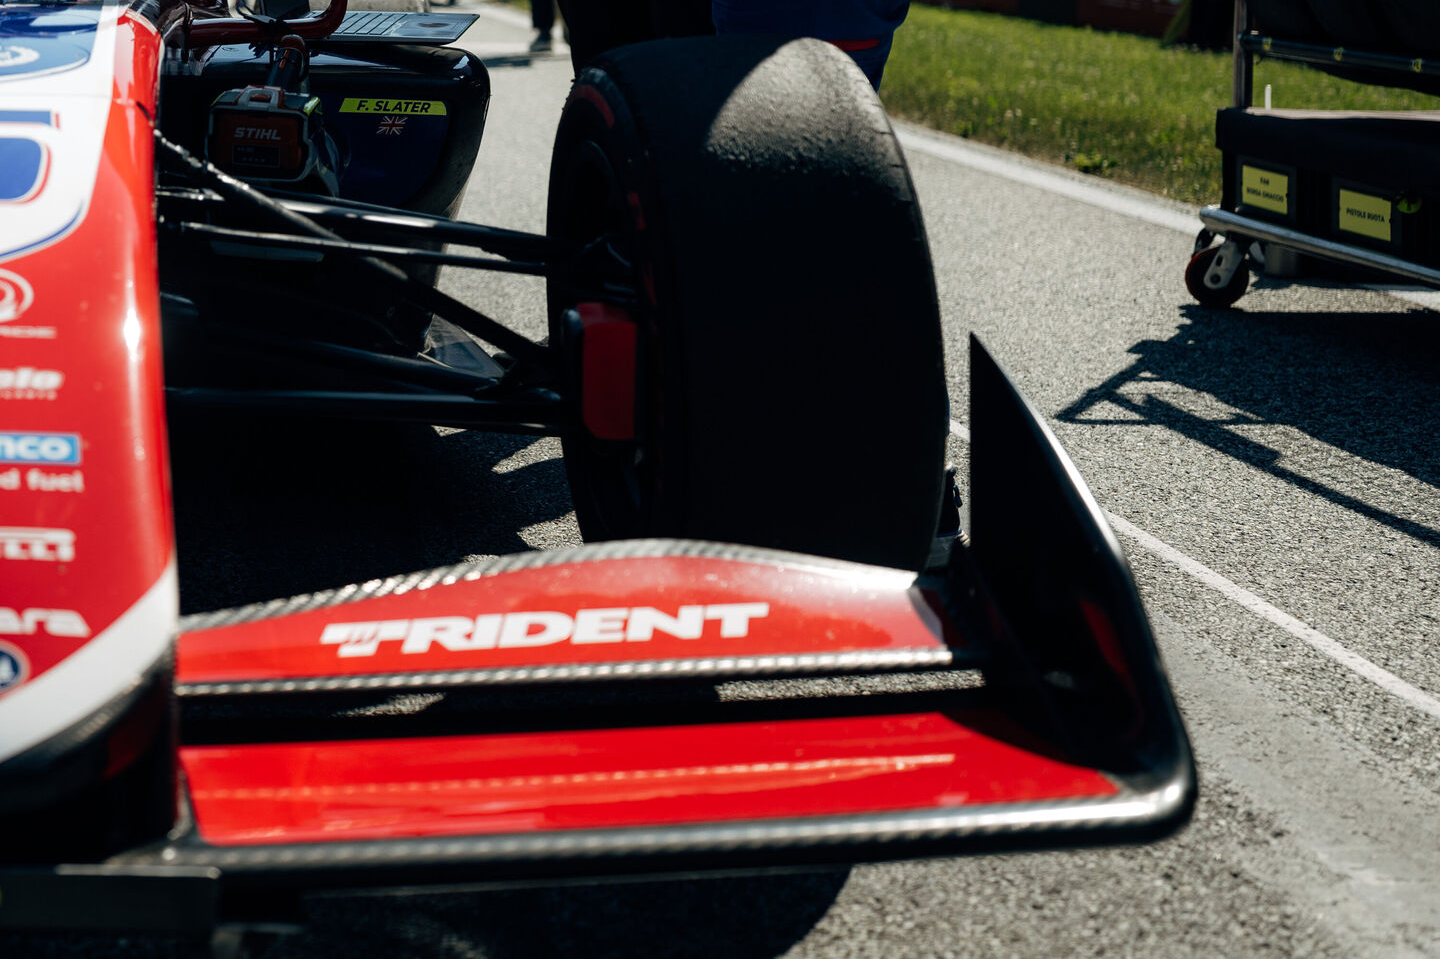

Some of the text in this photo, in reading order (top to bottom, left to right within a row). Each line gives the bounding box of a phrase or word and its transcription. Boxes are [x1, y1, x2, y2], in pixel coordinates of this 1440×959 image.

[356, 100, 431, 113] F. SLATER
[232, 126, 282, 141] STIHL
[26, 467, 85, 493] fuel
[320, 602, 770, 658] TRIDENT
